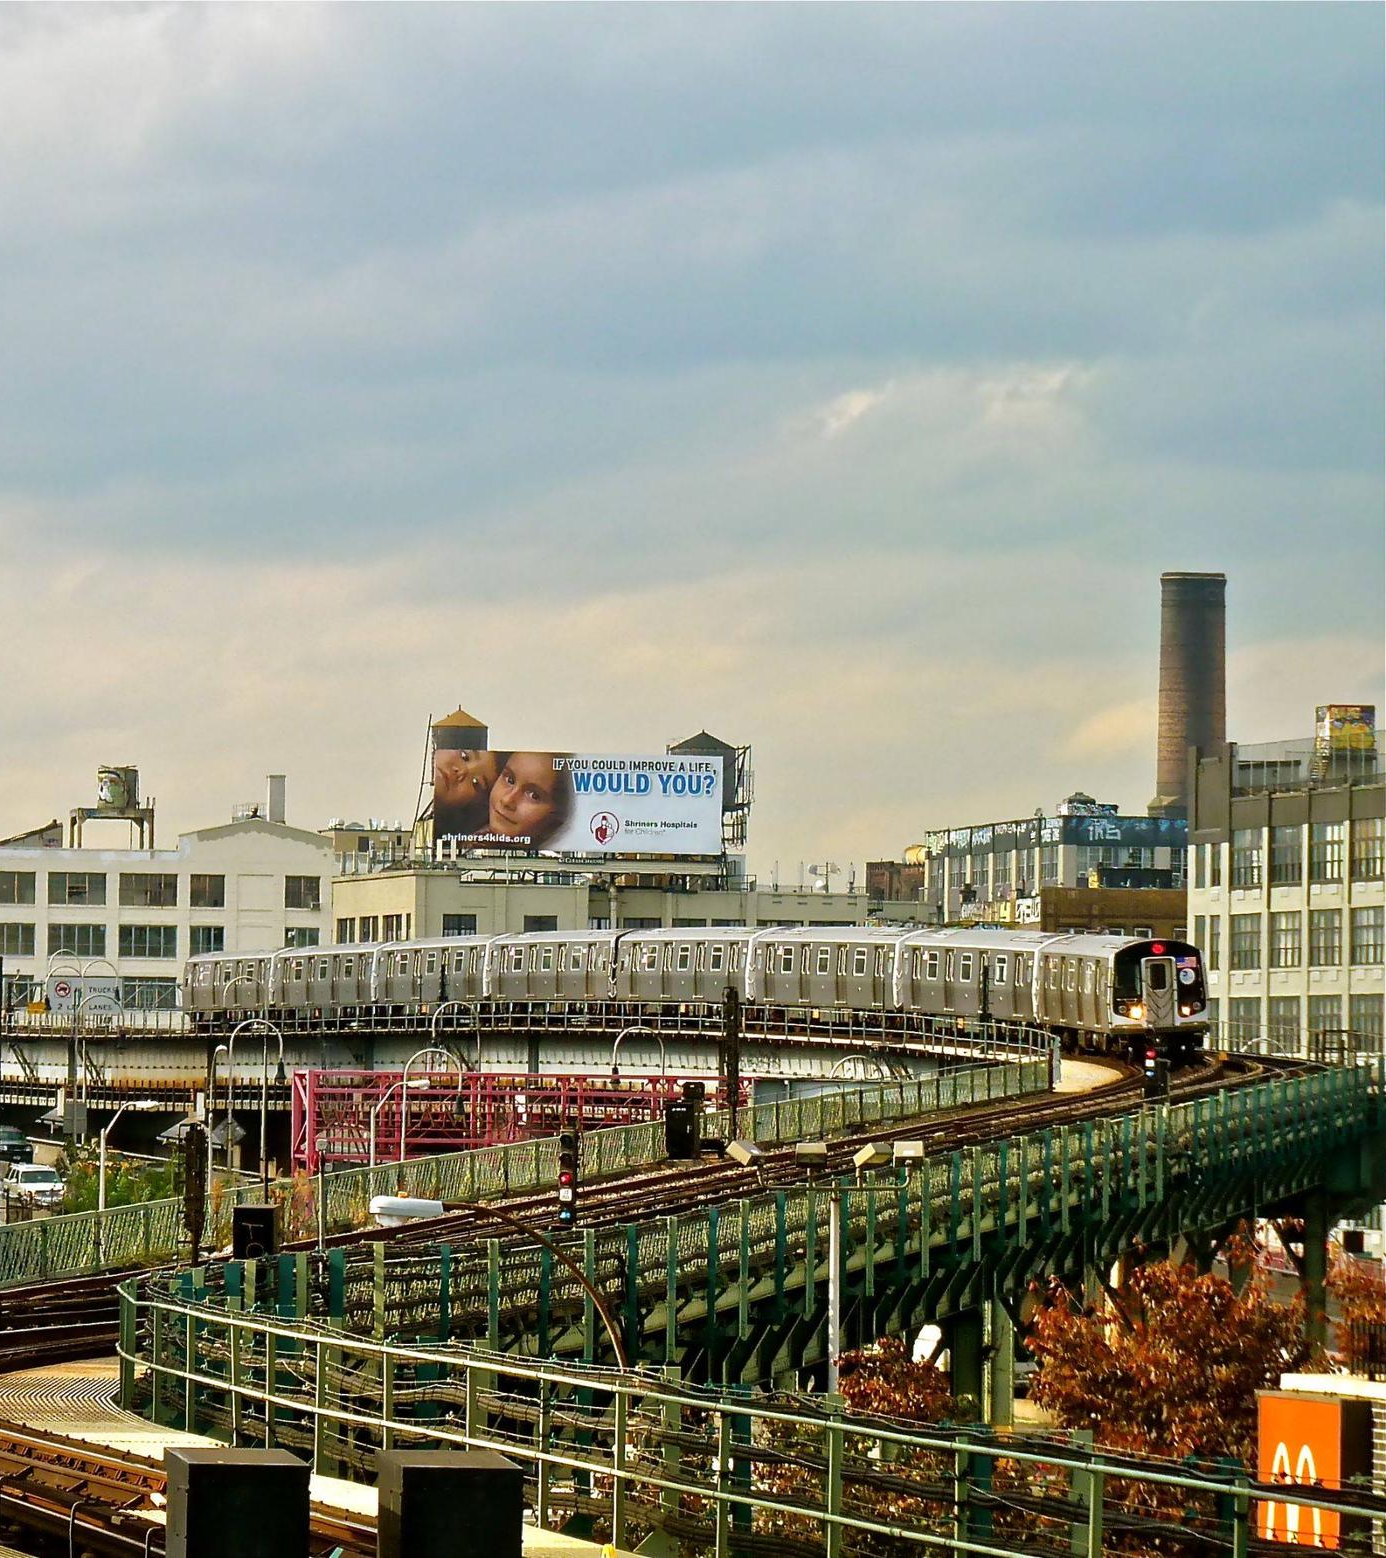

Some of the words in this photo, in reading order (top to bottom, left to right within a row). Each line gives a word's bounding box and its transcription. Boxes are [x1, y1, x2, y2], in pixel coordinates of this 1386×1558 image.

[553, 760, 563, 770] IF
[567, 760, 588, 770] YOU
[592, 760, 626, 771] COULD
[629, 761, 675, 772] IMPROVE
[679, 762, 685, 772] A
[689, 762, 717, 775] LIFE,
[573, 772, 650, 794] WOULD
[658, 773, 715, 795] YOU?
[624, 820, 658, 828] Shriners
[660, 821, 698, 830] Hospitals
[441, 832, 531, 844] shriners4kids.org
